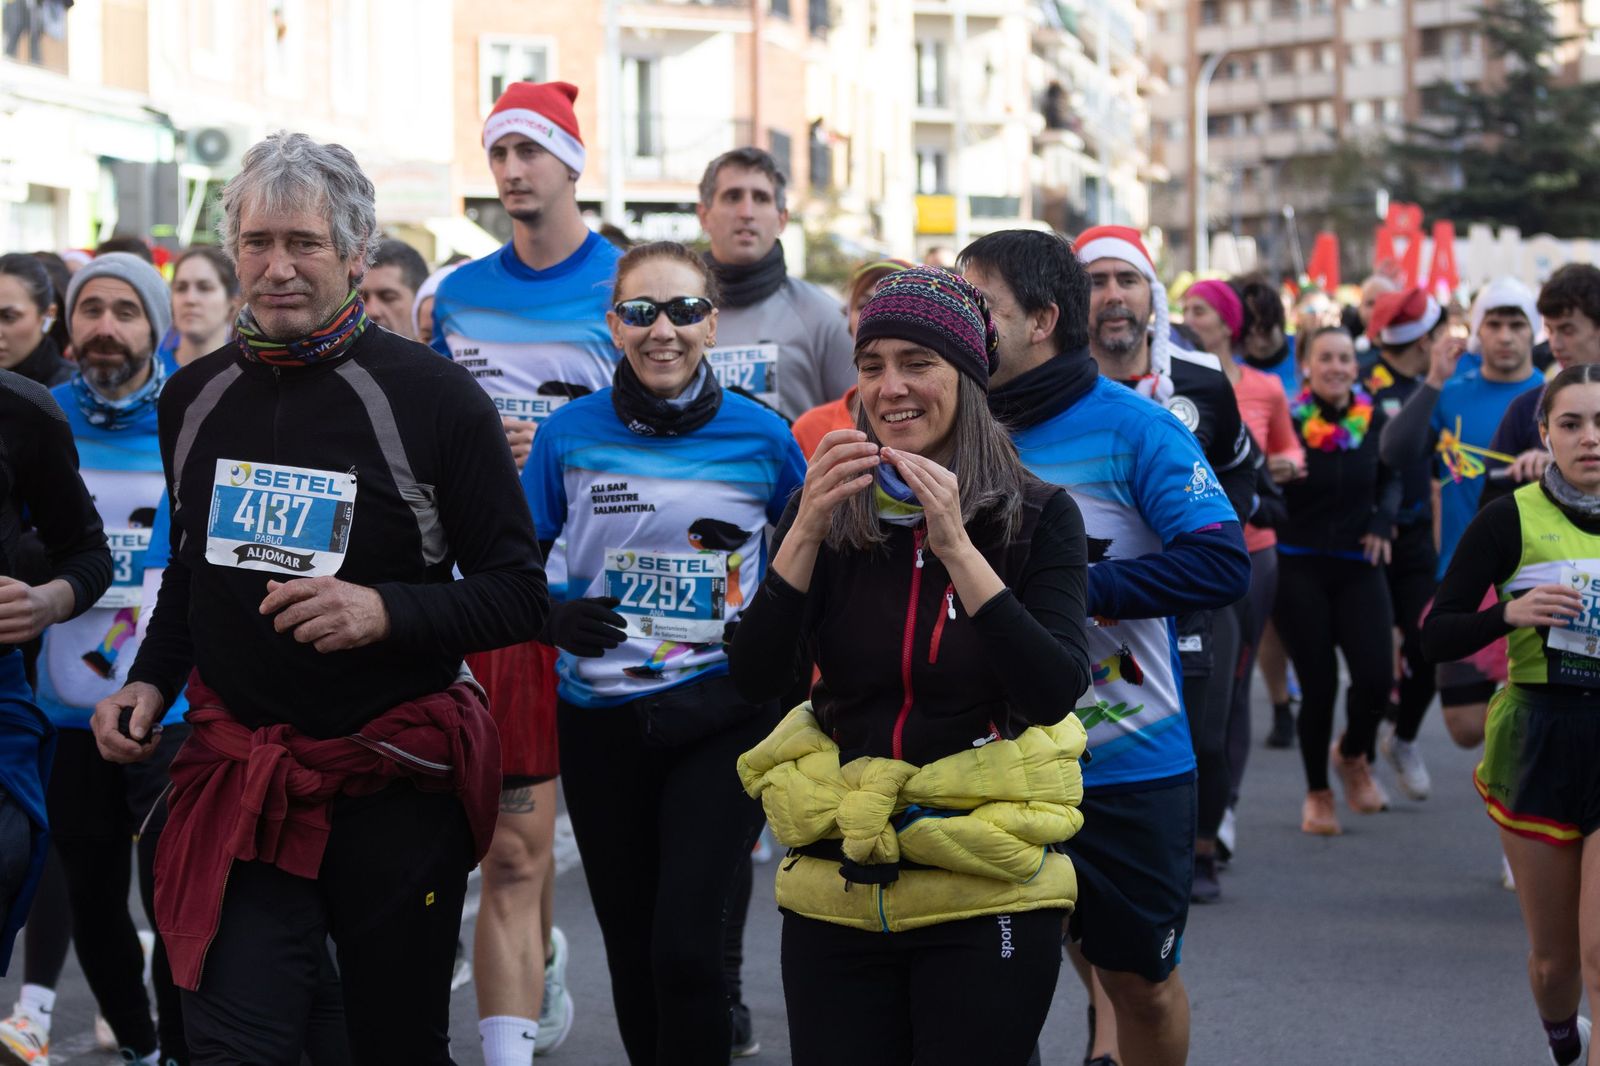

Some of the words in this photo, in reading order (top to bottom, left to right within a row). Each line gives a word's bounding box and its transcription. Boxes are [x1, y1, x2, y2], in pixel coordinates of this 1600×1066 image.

[711, 350, 767, 362] SETEL
[470, 369, 504, 378] ANTINA
[494, 398, 556, 413] SETEL
[254, 469, 342, 496] SETEL
[591, 484, 604, 493] XLI
[607, 482, 629, 491] SAN
[592, 493, 639, 504] SILVESTRE
[233, 490, 313, 538] 4137
[593, 504, 656, 515] SALMANTINA
[110, 535, 147, 546] TEL
[254, 533, 283, 546] PABLO
[246, 546, 300, 569] ALJOMAR
[638, 556, 714, 573] SETEL
[621, 573, 696, 613] 2292
[650, 609, 665, 617] ANA
